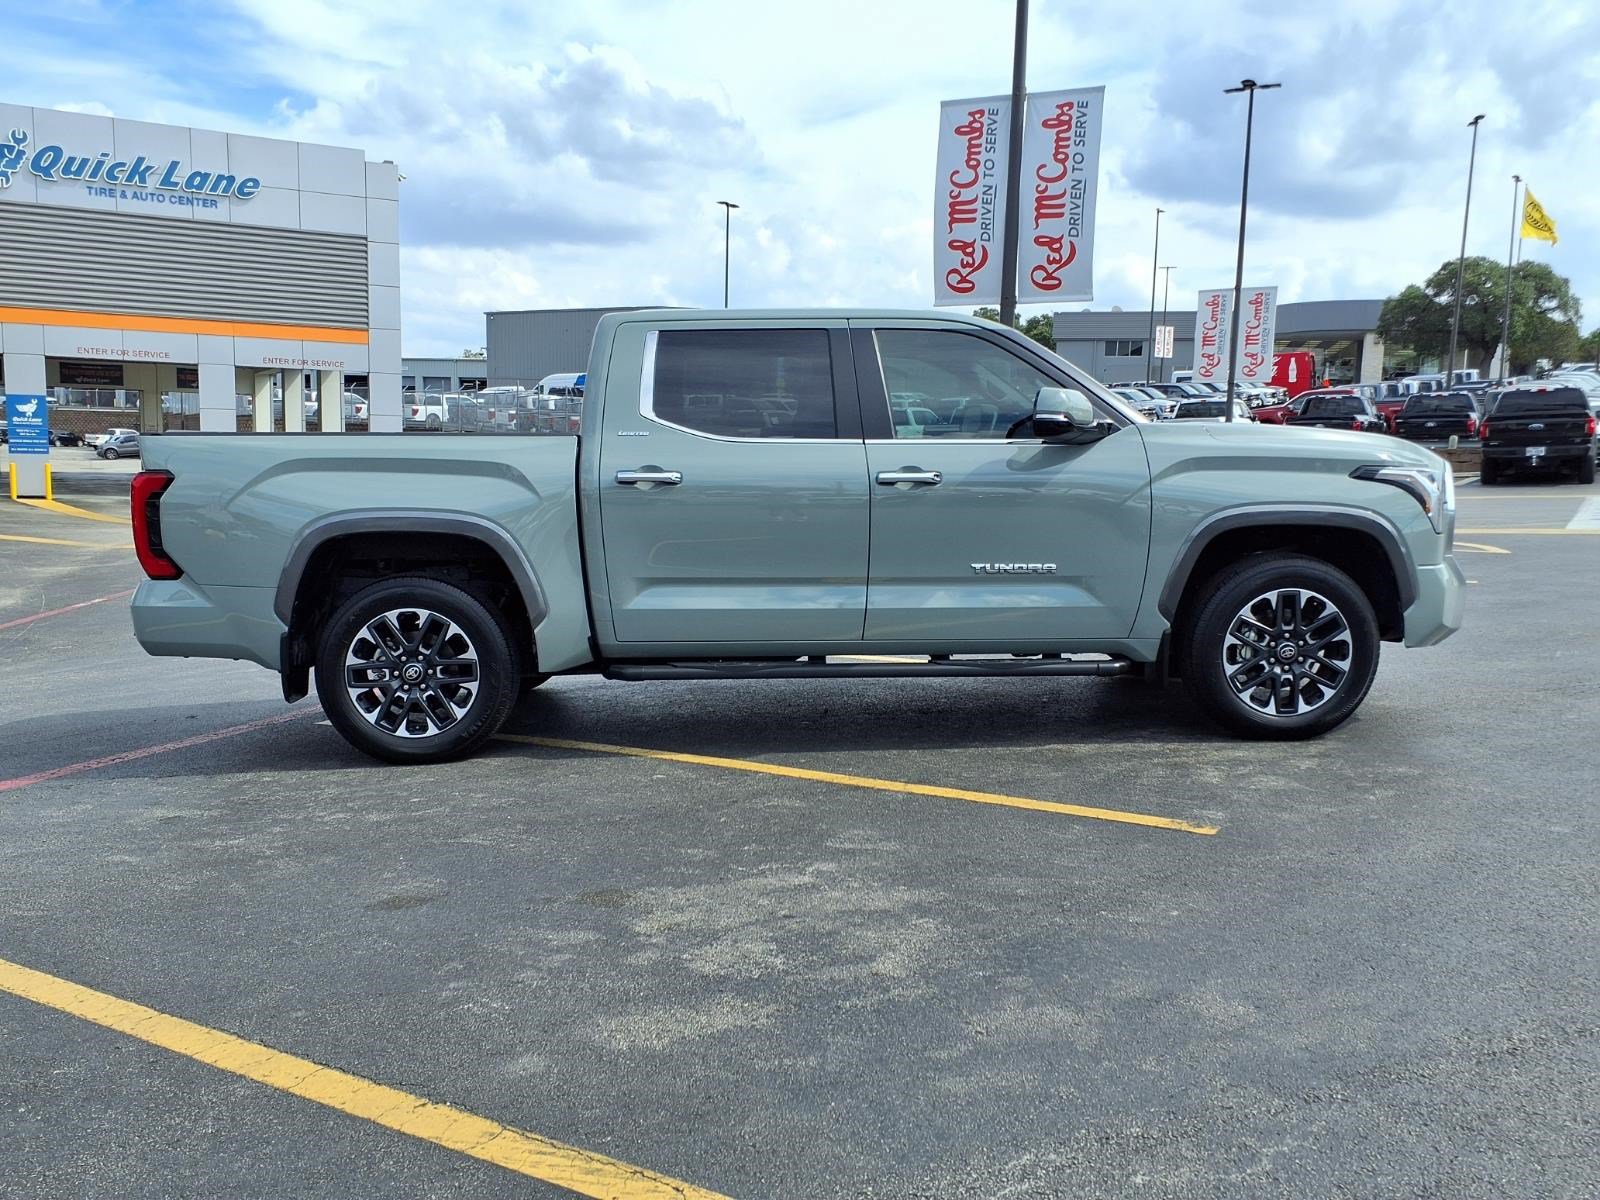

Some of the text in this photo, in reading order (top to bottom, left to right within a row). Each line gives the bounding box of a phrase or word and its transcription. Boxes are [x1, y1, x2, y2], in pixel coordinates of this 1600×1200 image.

[29, 145, 261, 199] Quick Lane
[86, 186, 218, 209] TIRE & AUTO CENTER
[946, 108, 988, 294] Red McCombs
[980, 107, 999, 242] DRIVEN TO SERVE
[1030, 101, 1076, 291] Red McCombs
[1068, 100, 1089, 238] DRIVEN TO SERVE
[77, 346, 171, 359] ENTER FOR SERVICE
[263, 357, 345, 368] ENTER FOR SERVICE
[1199, 294, 1221, 377] Red McCombs
[1242, 292, 1264, 377] Red McCombs
[970, 563, 1057, 575] TUNDRA
